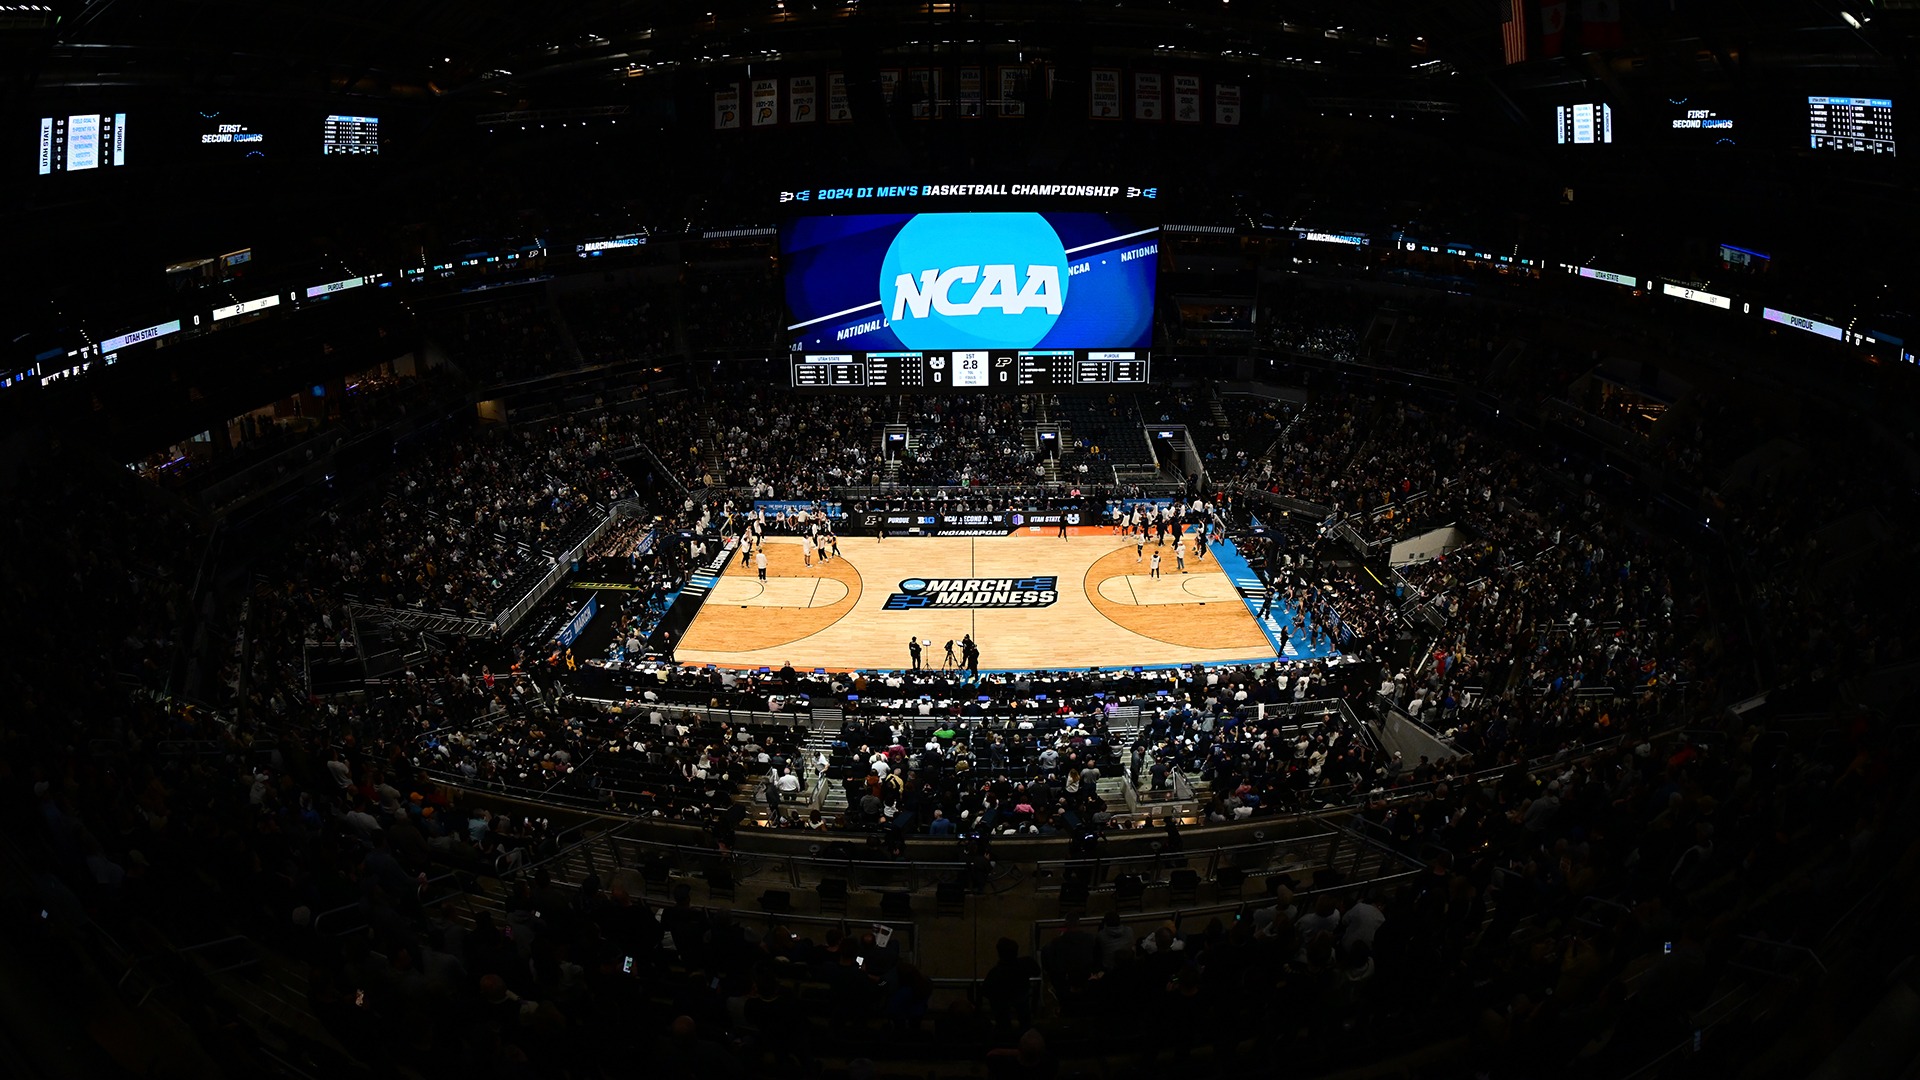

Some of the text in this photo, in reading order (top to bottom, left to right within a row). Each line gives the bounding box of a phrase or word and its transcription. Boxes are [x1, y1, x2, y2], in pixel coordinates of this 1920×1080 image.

[1688, 110, 1709, 118] FIRST
[218, 124, 241, 132] FIRST
[1672, 120, 1733, 128] SECOND ROUNDS
[202, 134, 263, 143] SECOND ROUNDS
[818, 184, 1120, 200] 2024 DI MEN'S BASKETBALL CHAMPIONSHIP
[1068, 262, 1090, 276] NCAA
[1595, 271, 1619, 282] UTAH STATE
[327, 282, 344, 292] PURDUE
[1647, 280, 1652, 290] 0
[290, 292, 296, 300] 0
[892, 264, 1062, 321] NCAA
[1684, 289, 1694, 299] 2.7
[236, 304, 244, 314] 2.7
[1744, 302, 1750, 314] 0
[194, 314, 200, 326] 0
[1790, 316, 1814, 330] PURDUE
[837, 319, 880, 340] NATIONAL
[124, 327, 158, 344] UTAH STATE
[963, 360, 978, 370] 2.8
[934, 372, 942, 382] 0
[1000, 371, 1008, 382] 0
[926, 580, 1013, 592] MARCH
[936, 591, 1054, 604] MADNESS
[573, 607, 592, 635] MARCH
